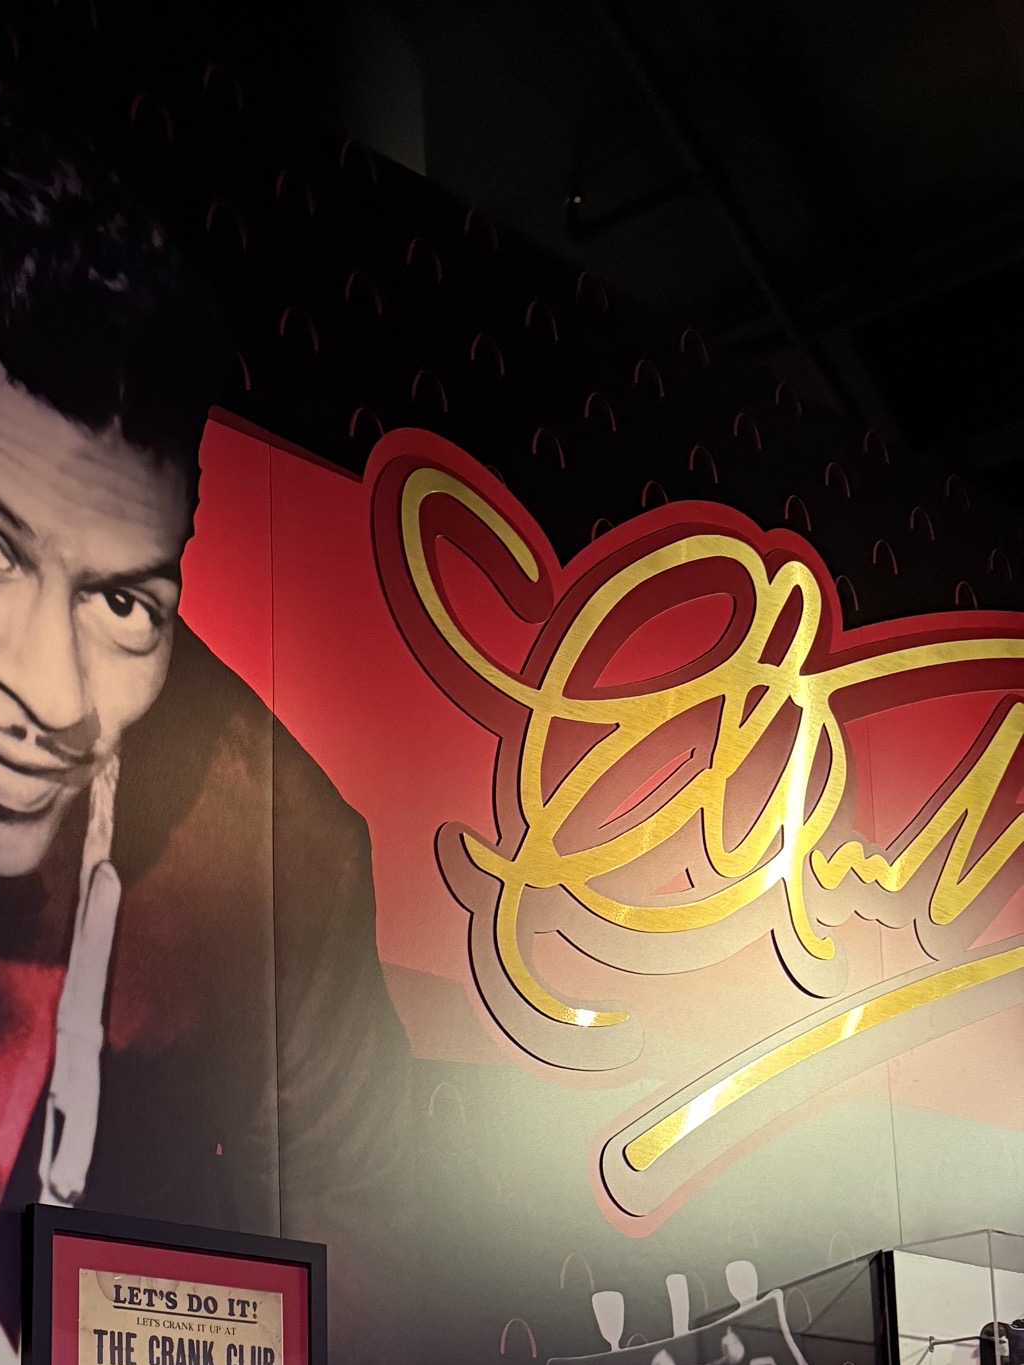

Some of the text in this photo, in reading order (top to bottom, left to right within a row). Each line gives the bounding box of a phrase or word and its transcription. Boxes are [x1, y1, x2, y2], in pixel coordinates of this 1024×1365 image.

[113, 1284, 258, 1318] LET'S DO IT!
[137, 1317, 236, 1336] LET'S CRANK IT UP AT
